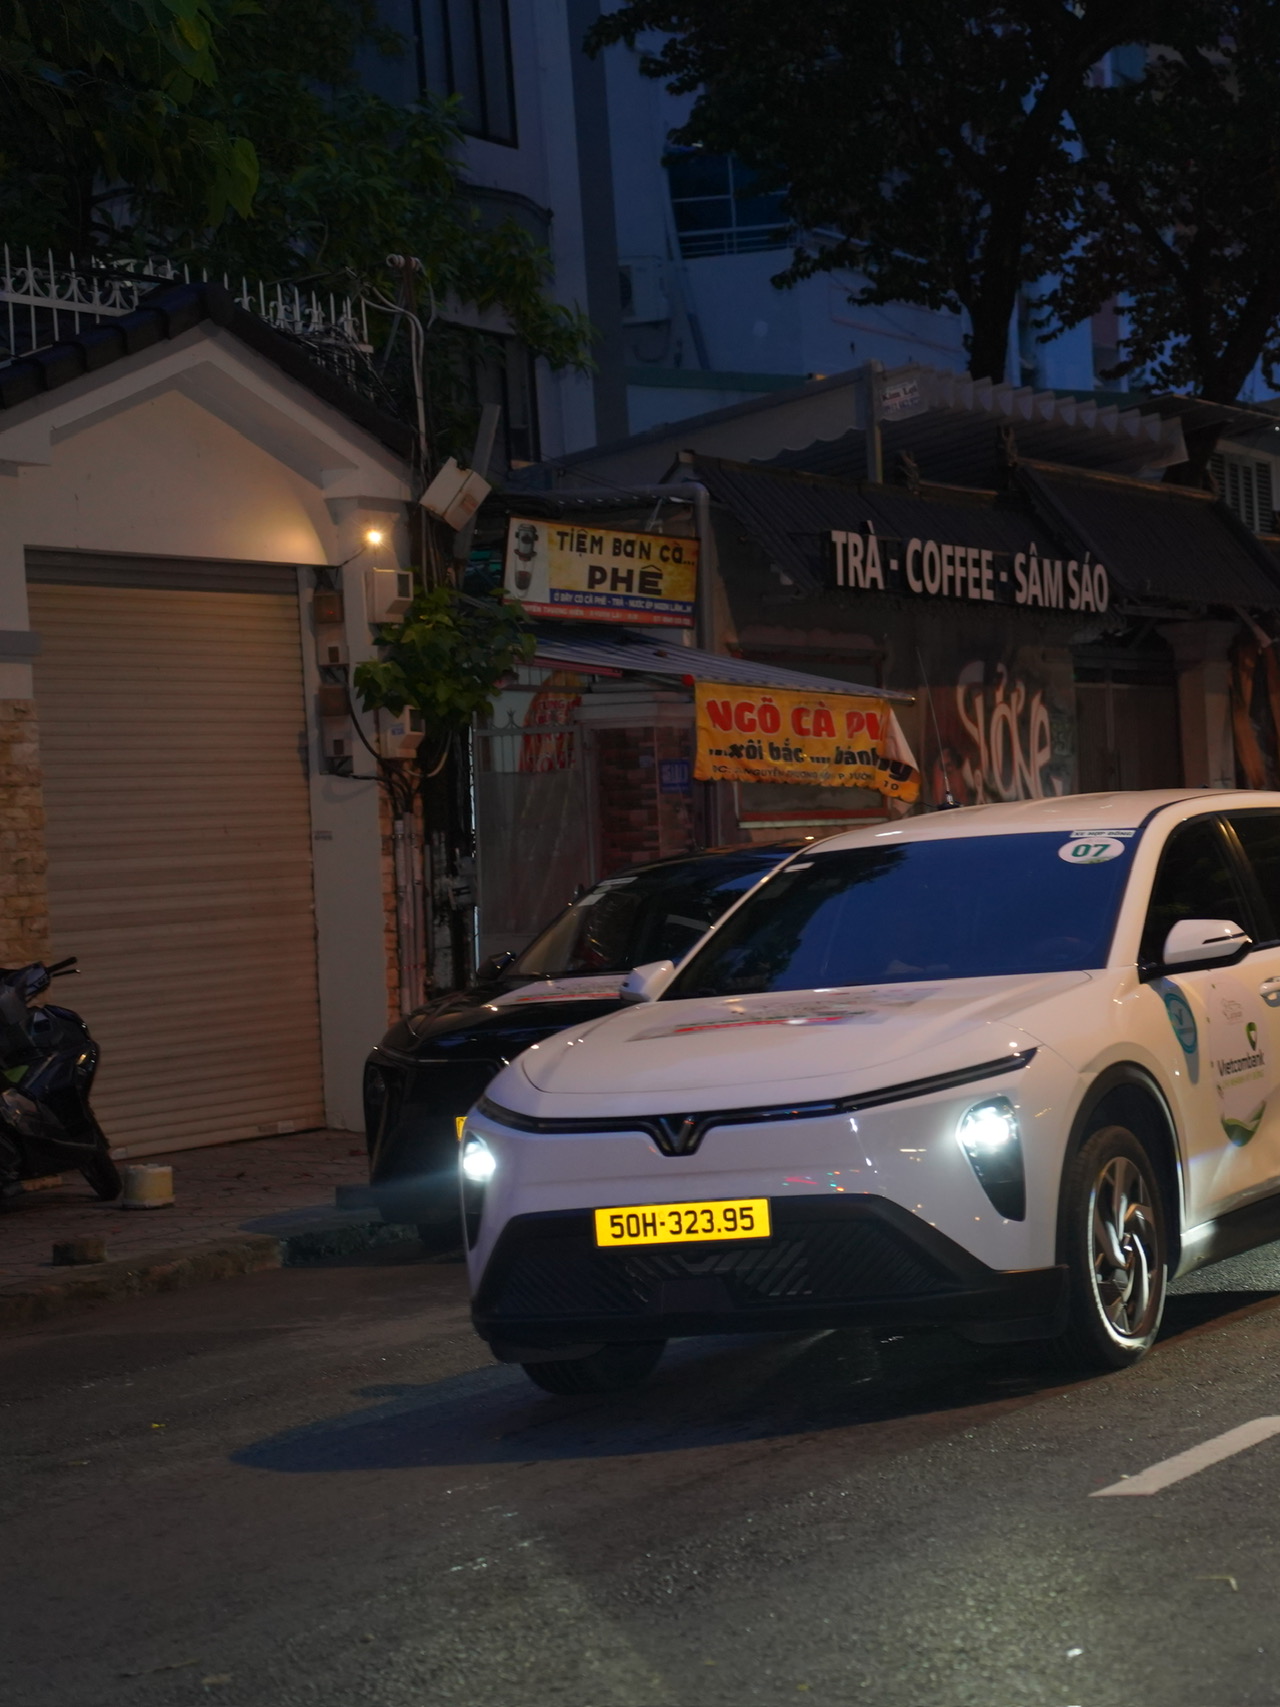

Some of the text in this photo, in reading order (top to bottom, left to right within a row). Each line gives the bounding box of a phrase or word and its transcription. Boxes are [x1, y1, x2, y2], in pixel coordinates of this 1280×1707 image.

[556, 528, 603, 557] TIỆM
[588, 564, 663, 595] PHÊ
[831, 520, 885, 590] TRÀ
[905, 537, 995, 601] COFFEE
[1014, 542, 1064, 610] SÂM
[1067, 551, 1109, 613] SÁO
[705, 695, 781, 734] NGÕ
[791, 701, 836, 738] CÀ
[768, 738, 804, 763] bắc
[1071, 844, 1111, 857] 07
[1217, 1049, 1265, 1077] Vietcombank
[609, 1206, 754, 1239] 50H-323.95
